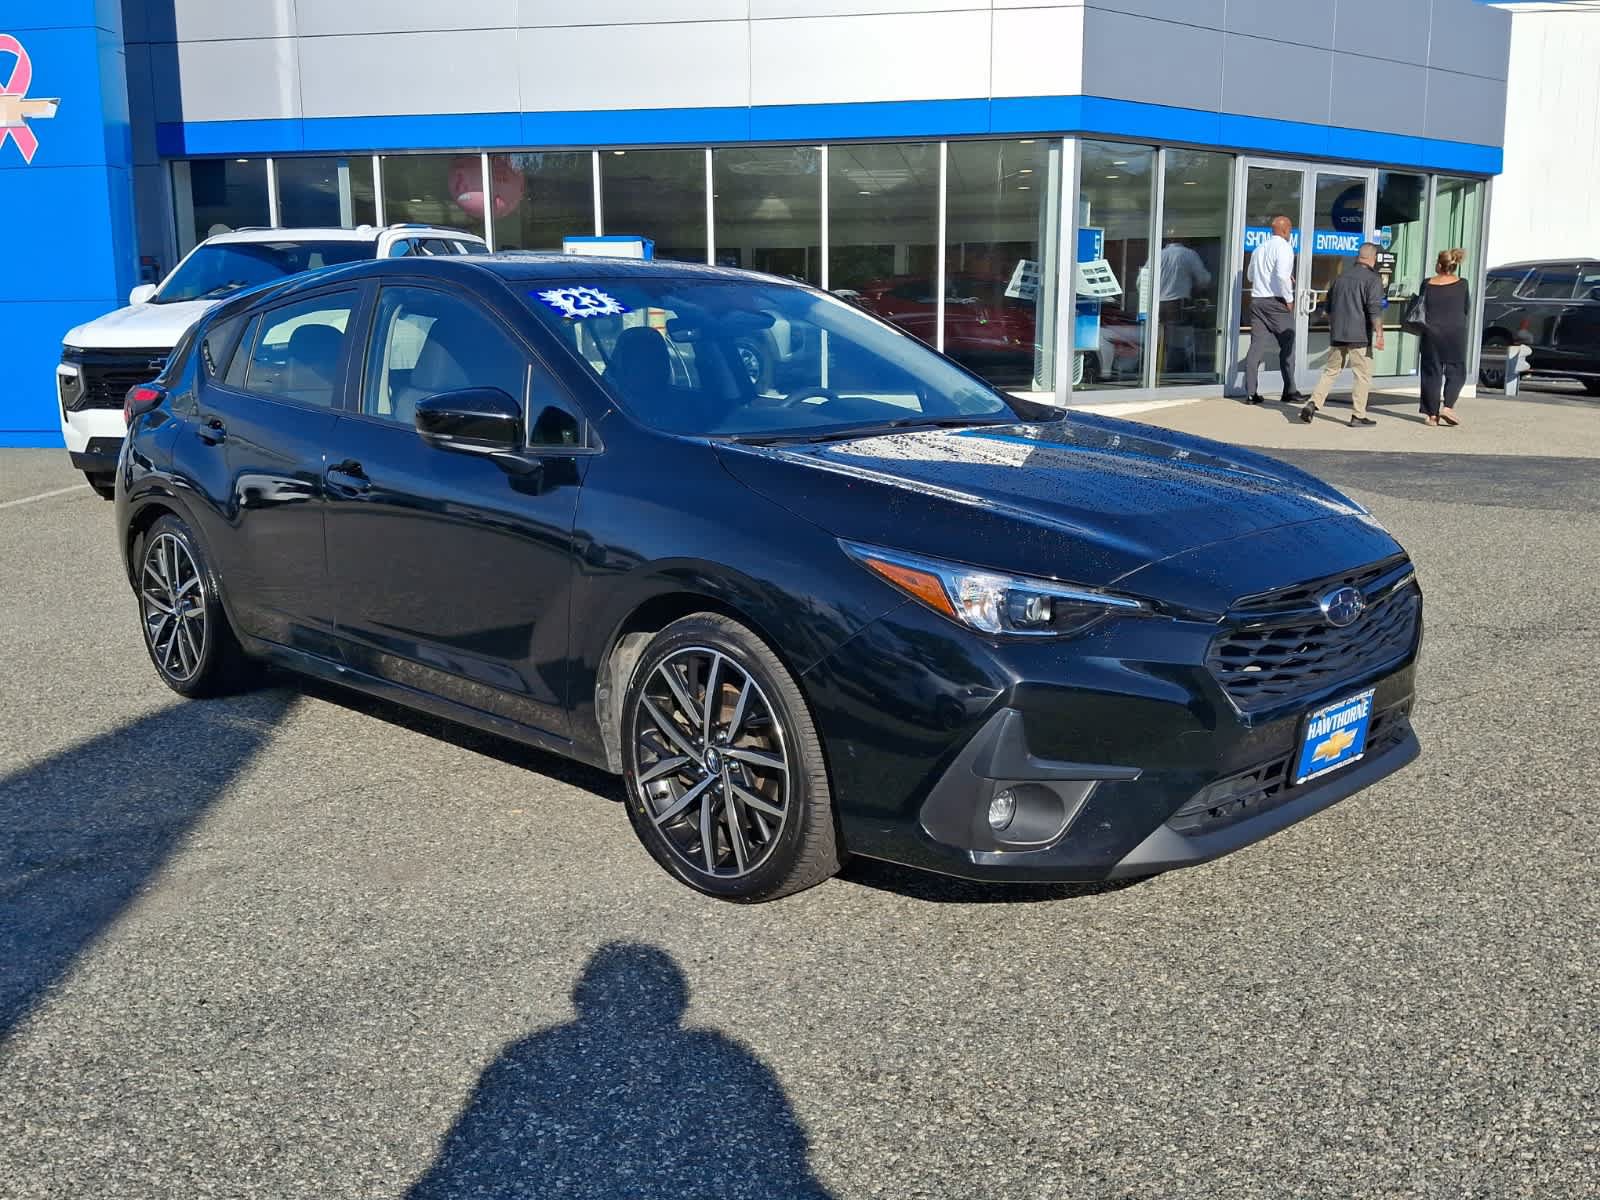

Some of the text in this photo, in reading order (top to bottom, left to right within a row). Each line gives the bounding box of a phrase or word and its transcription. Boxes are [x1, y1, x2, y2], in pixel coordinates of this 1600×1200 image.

[1246, 231, 1299, 249] SHOWM
[1316, 234, 1360, 252] ENTRANCE
[560, 292, 608, 311] 23
[1307, 700, 1369, 740] HAWTHORNE
